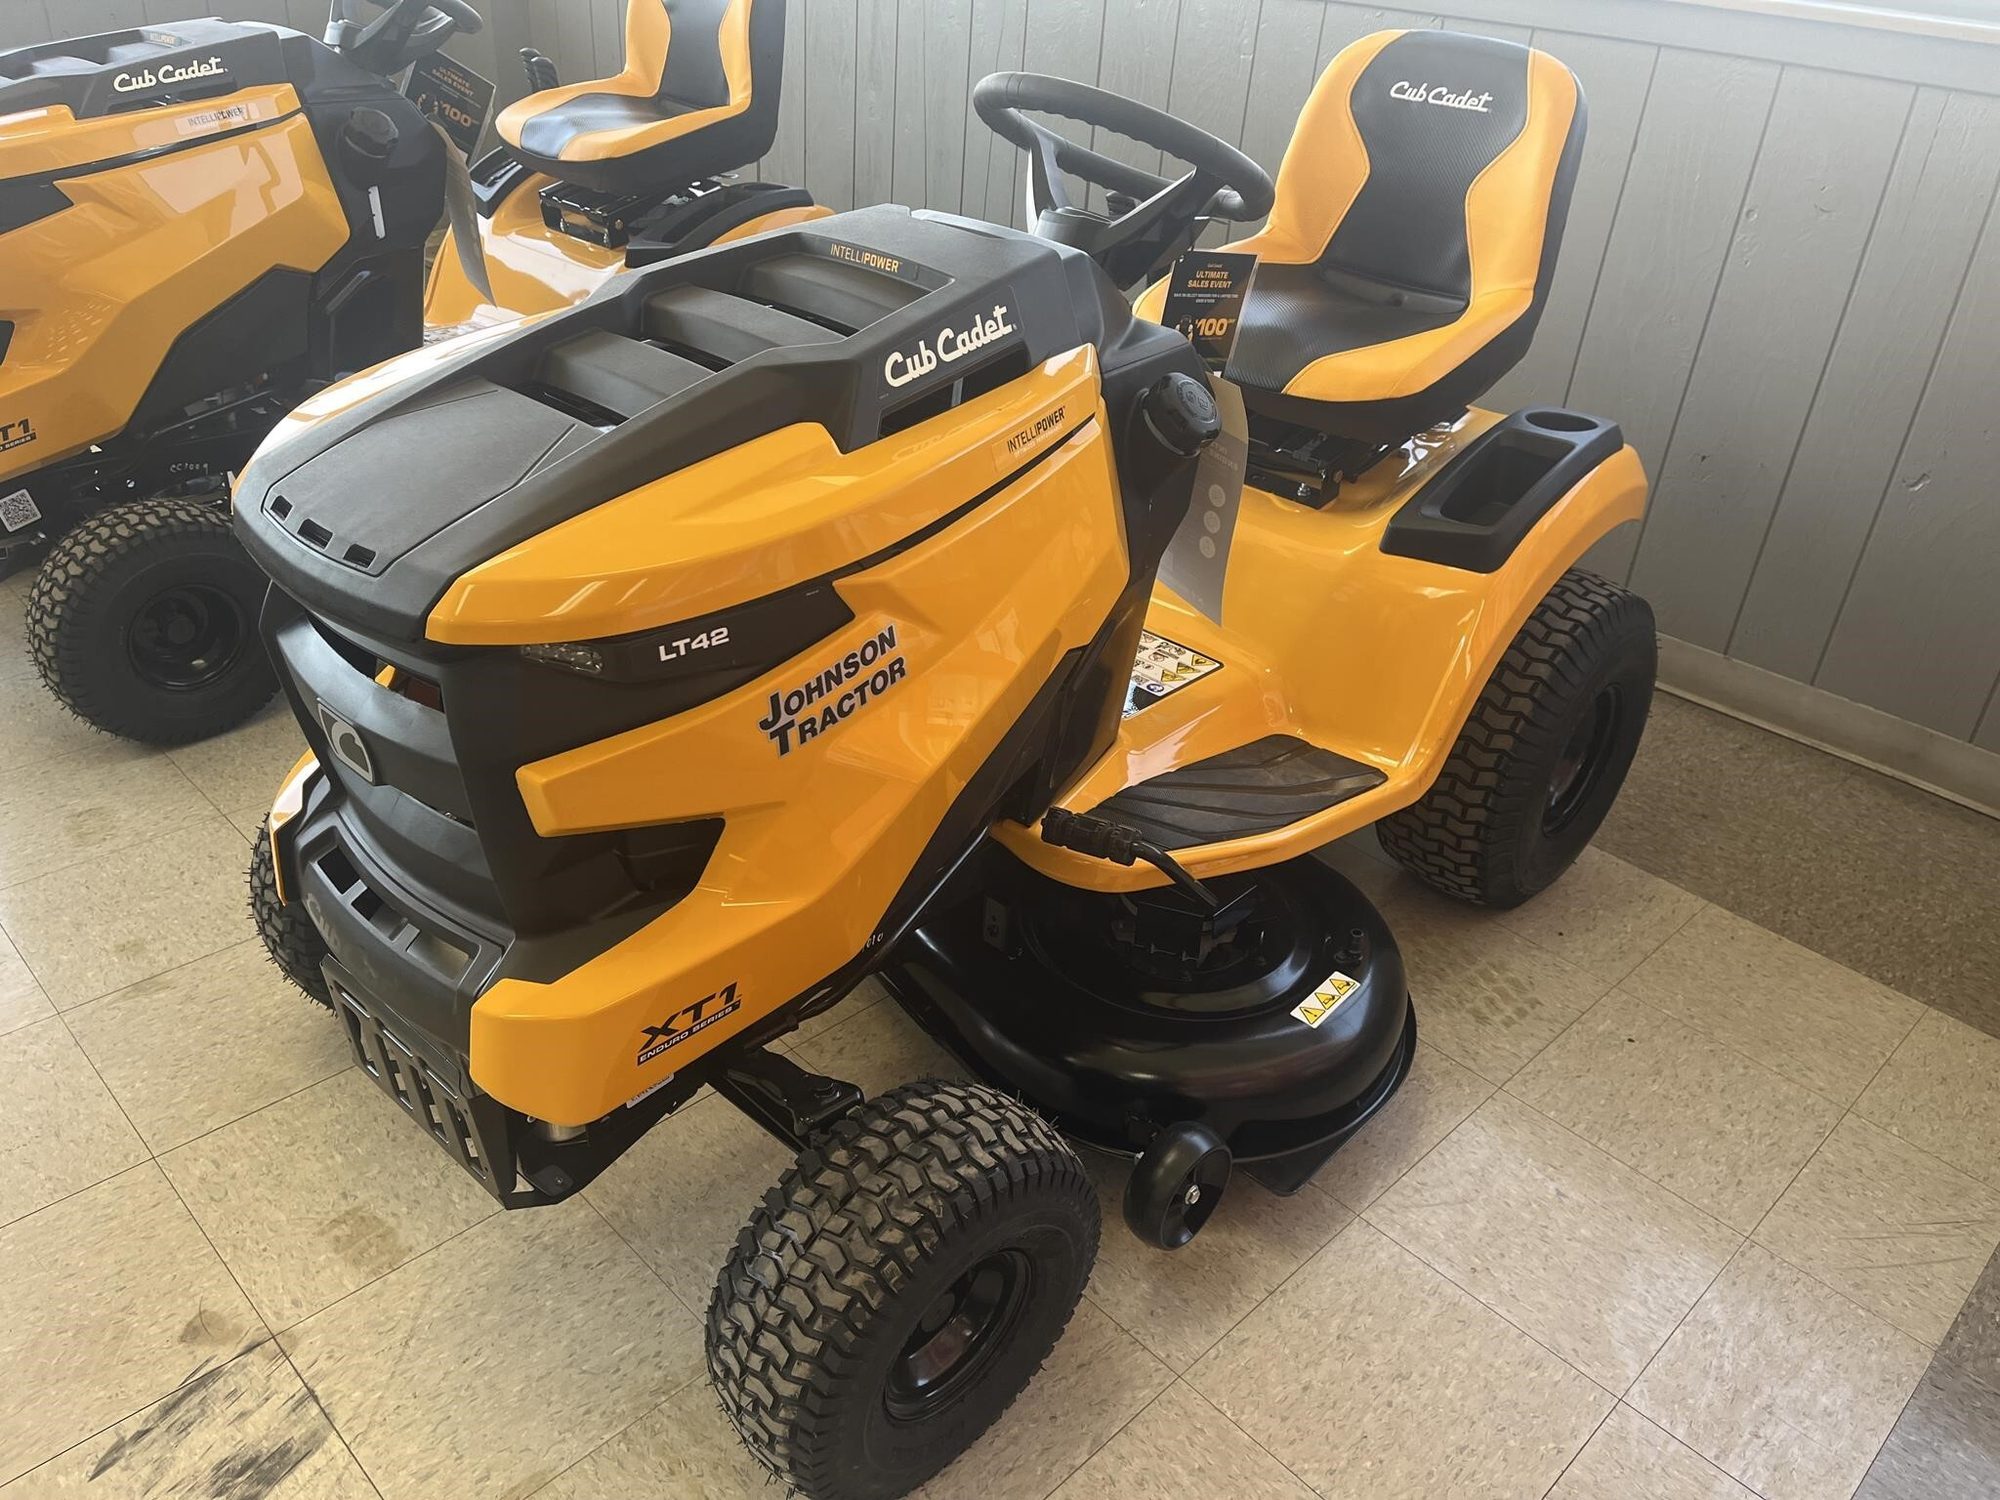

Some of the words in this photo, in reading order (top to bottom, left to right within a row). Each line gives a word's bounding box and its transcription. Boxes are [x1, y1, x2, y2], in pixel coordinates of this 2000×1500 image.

[113, 69, 157, 93] Cub
[158, 56, 225, 84] Cadet
[1390, 81, 1427, 102] Cub
[1427, 87, 1493, 113] Cadet
[830, 243, 899, 273] INTELLIPOWER
[1196, 270, 1229, 279] ULTIMATE
[1187, 280, 1209, 288] SALES
[1209, 280, 1233, 289] EVENT
[885, 340, 938, 388] Cub
[937, 305, 1013, 362] Cadet
[1006, 405, 1065, 454] INTELLIPOWER
[658, 627, 730, 662] LT42
[758, 624, 897, 731] JOHNSON
[769, 656, 906, 757] TRACTOR
[638, 981, 738, 1053] XT1
[639, 1031, 689, 1063] ENDURO
[692, 1006, 733, 1033] SERIES
